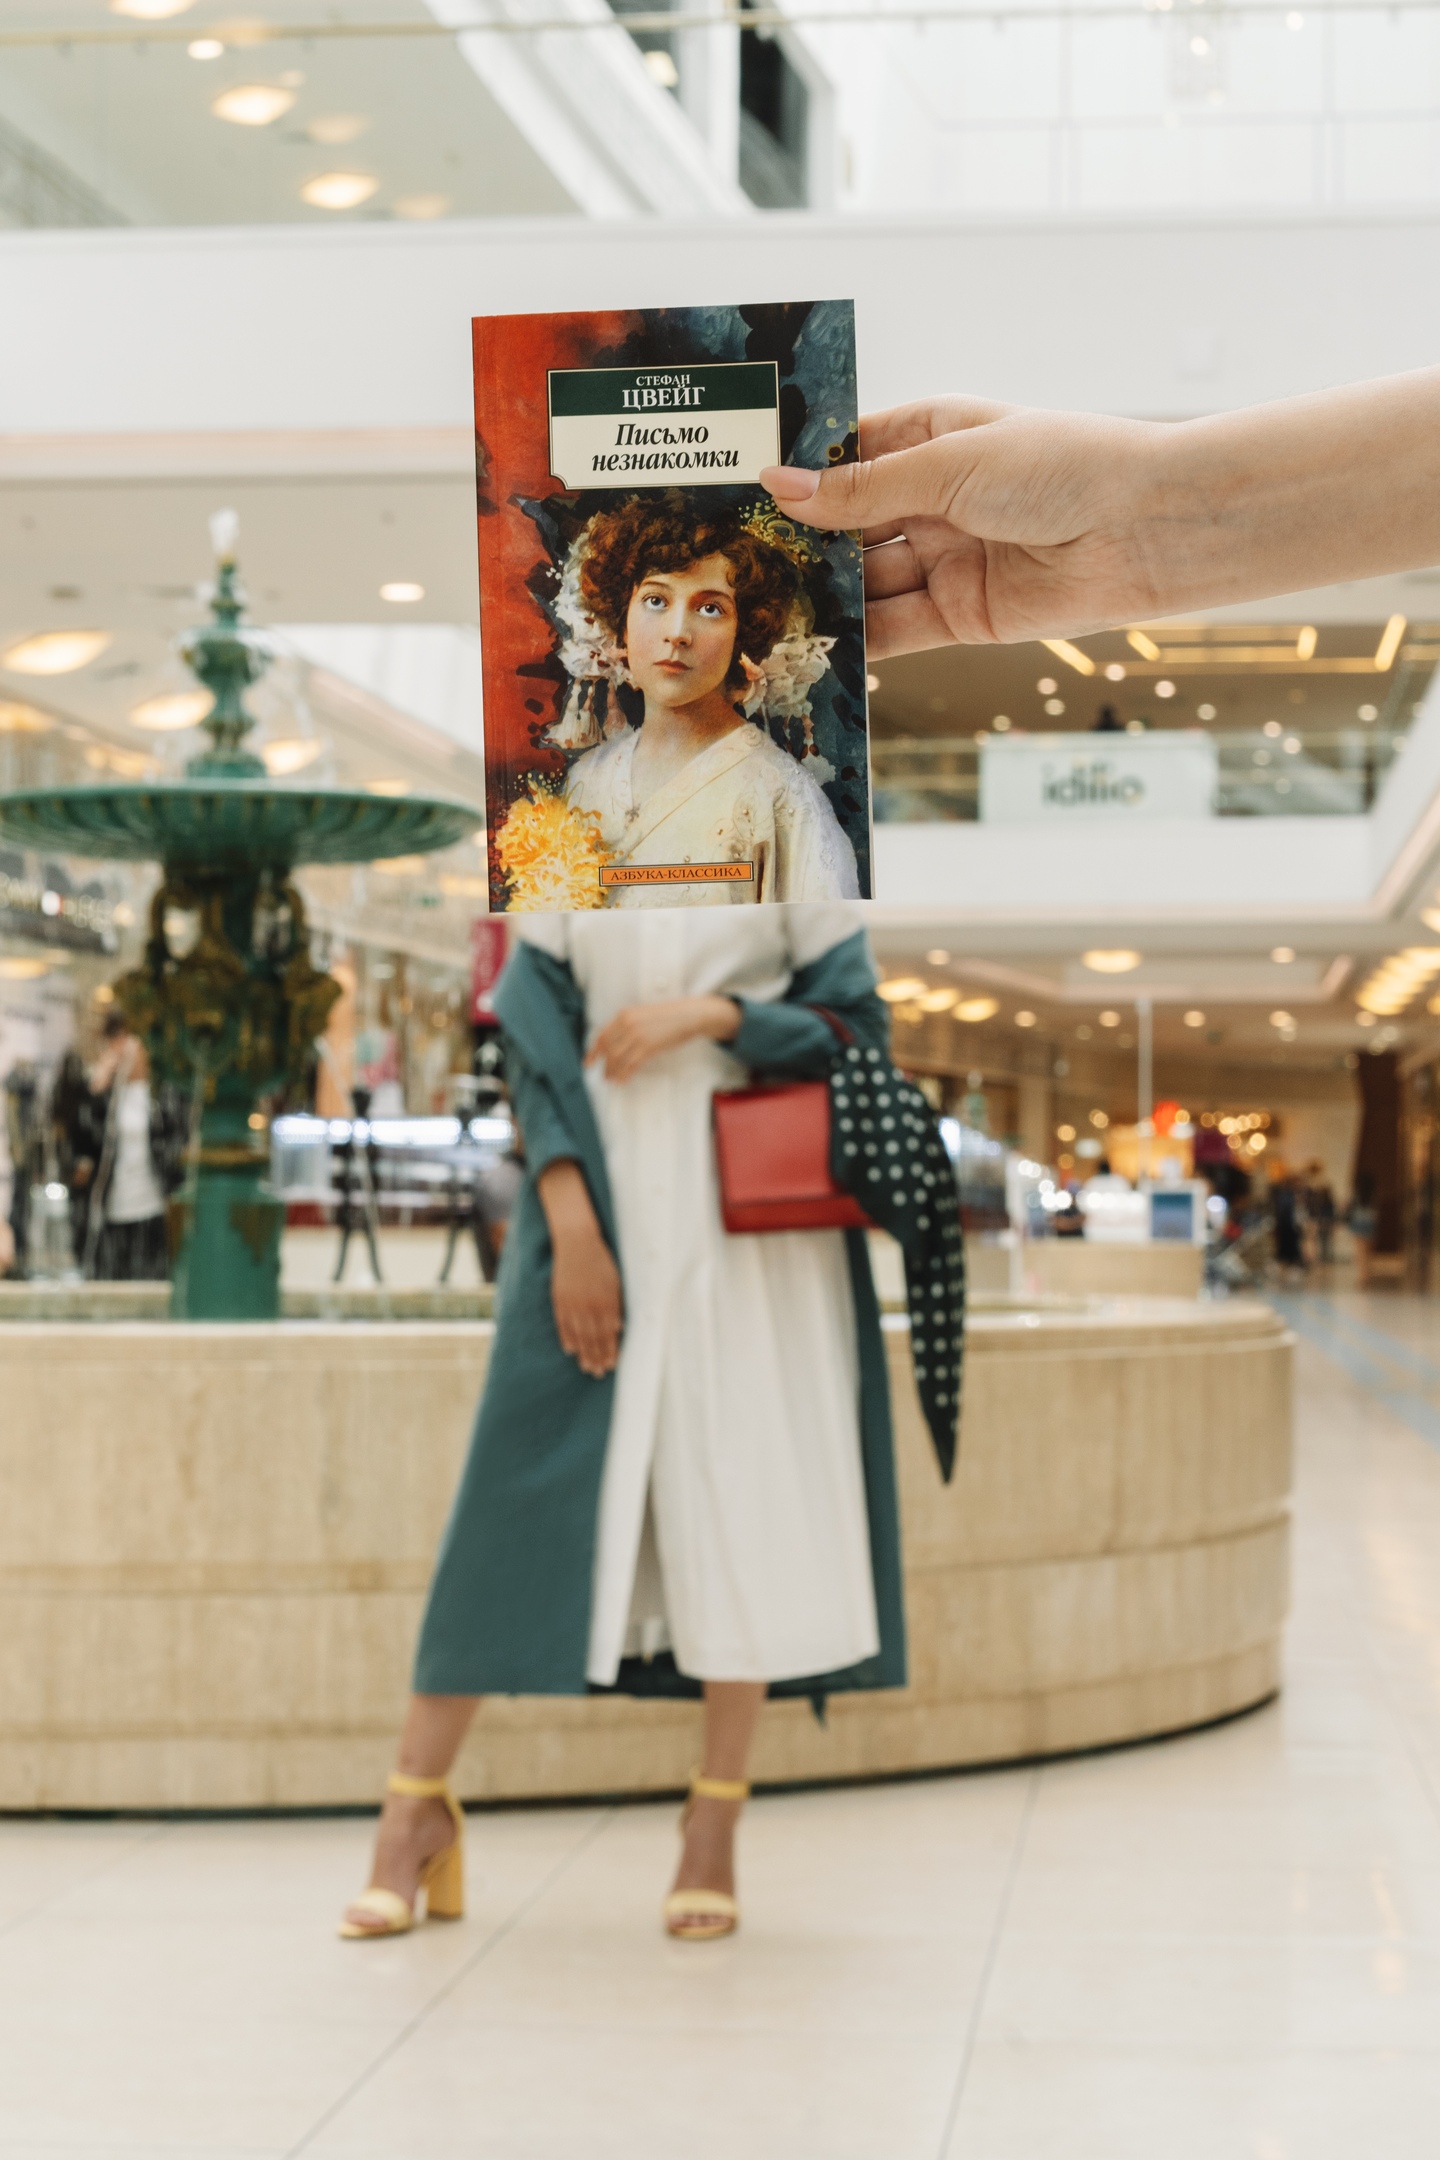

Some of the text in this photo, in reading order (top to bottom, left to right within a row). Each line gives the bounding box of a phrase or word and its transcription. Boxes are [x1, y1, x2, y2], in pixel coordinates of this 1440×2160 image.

[635, 374, 691, 386] СТЕФАН
[622, 384, 706, 410] ЦВЕЙГ
[614, 423, 709, 446] Письмо
[592, 449, 740, 471] незнакомки
[610, 867, 742, 881] АЗБУКА-КЛАССИКА
